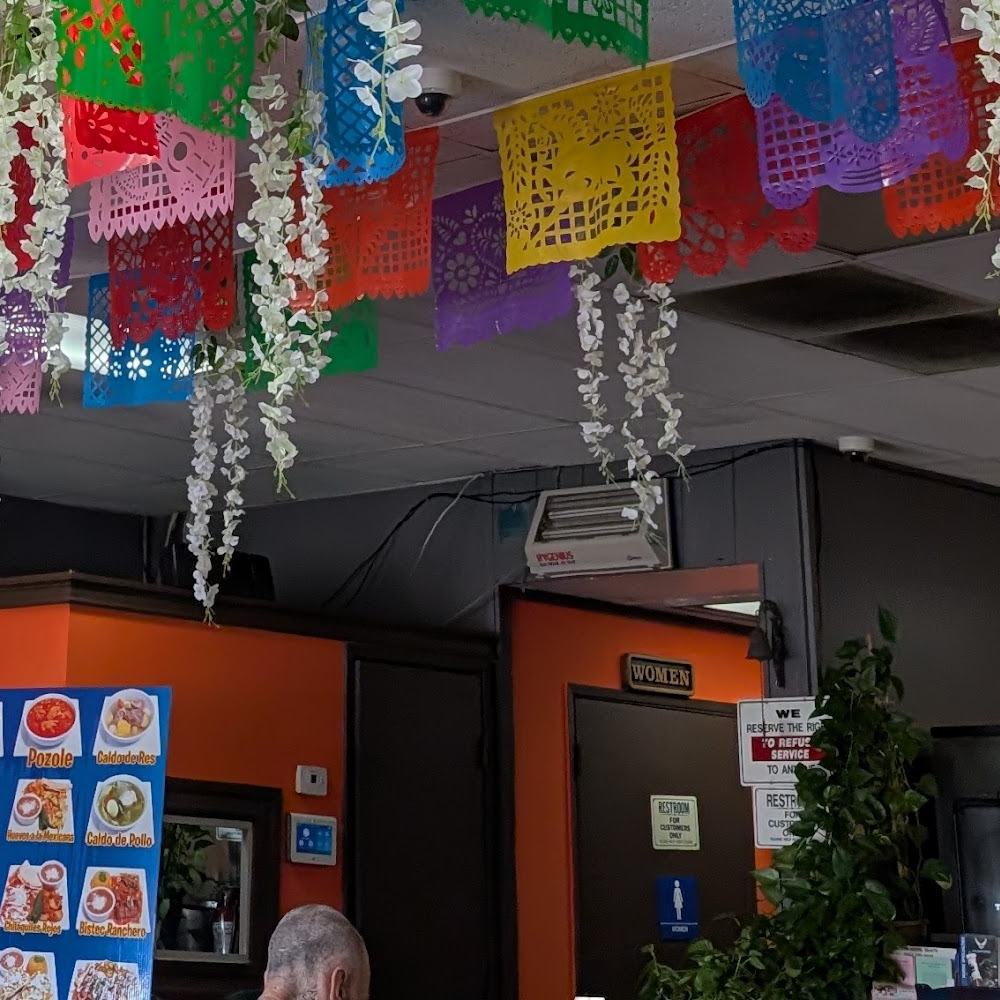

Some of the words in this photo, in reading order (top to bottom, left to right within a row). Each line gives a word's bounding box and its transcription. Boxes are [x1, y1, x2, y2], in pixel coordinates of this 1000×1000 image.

[631, 664, 690, 686] WOMEN
[776, 709, 801, 719] WE
[746, 722, 784, 733] RESERVE
[786, 722, 803, 732] THE
[806, 721, 823, 732] RIG
[762, 737, 775, 748] TO
[778, 737, 812, 748] REFUS
[27, 749, 73, 768] Pozole
[771, 749, 810, 760] SERVICE
[767, 764, 779, 774] TO
[658, 801, 691, 814] RESTROOM
[766, 794, 797, 808] RESTR
[87, 831, 112, 845] Caldo
[115, 832, 127, 845] de
[130, 833, 152, 846] Pollo
[80, 921, 105, 935] Bistec
[107, 923, 146, 937] Ranchero
